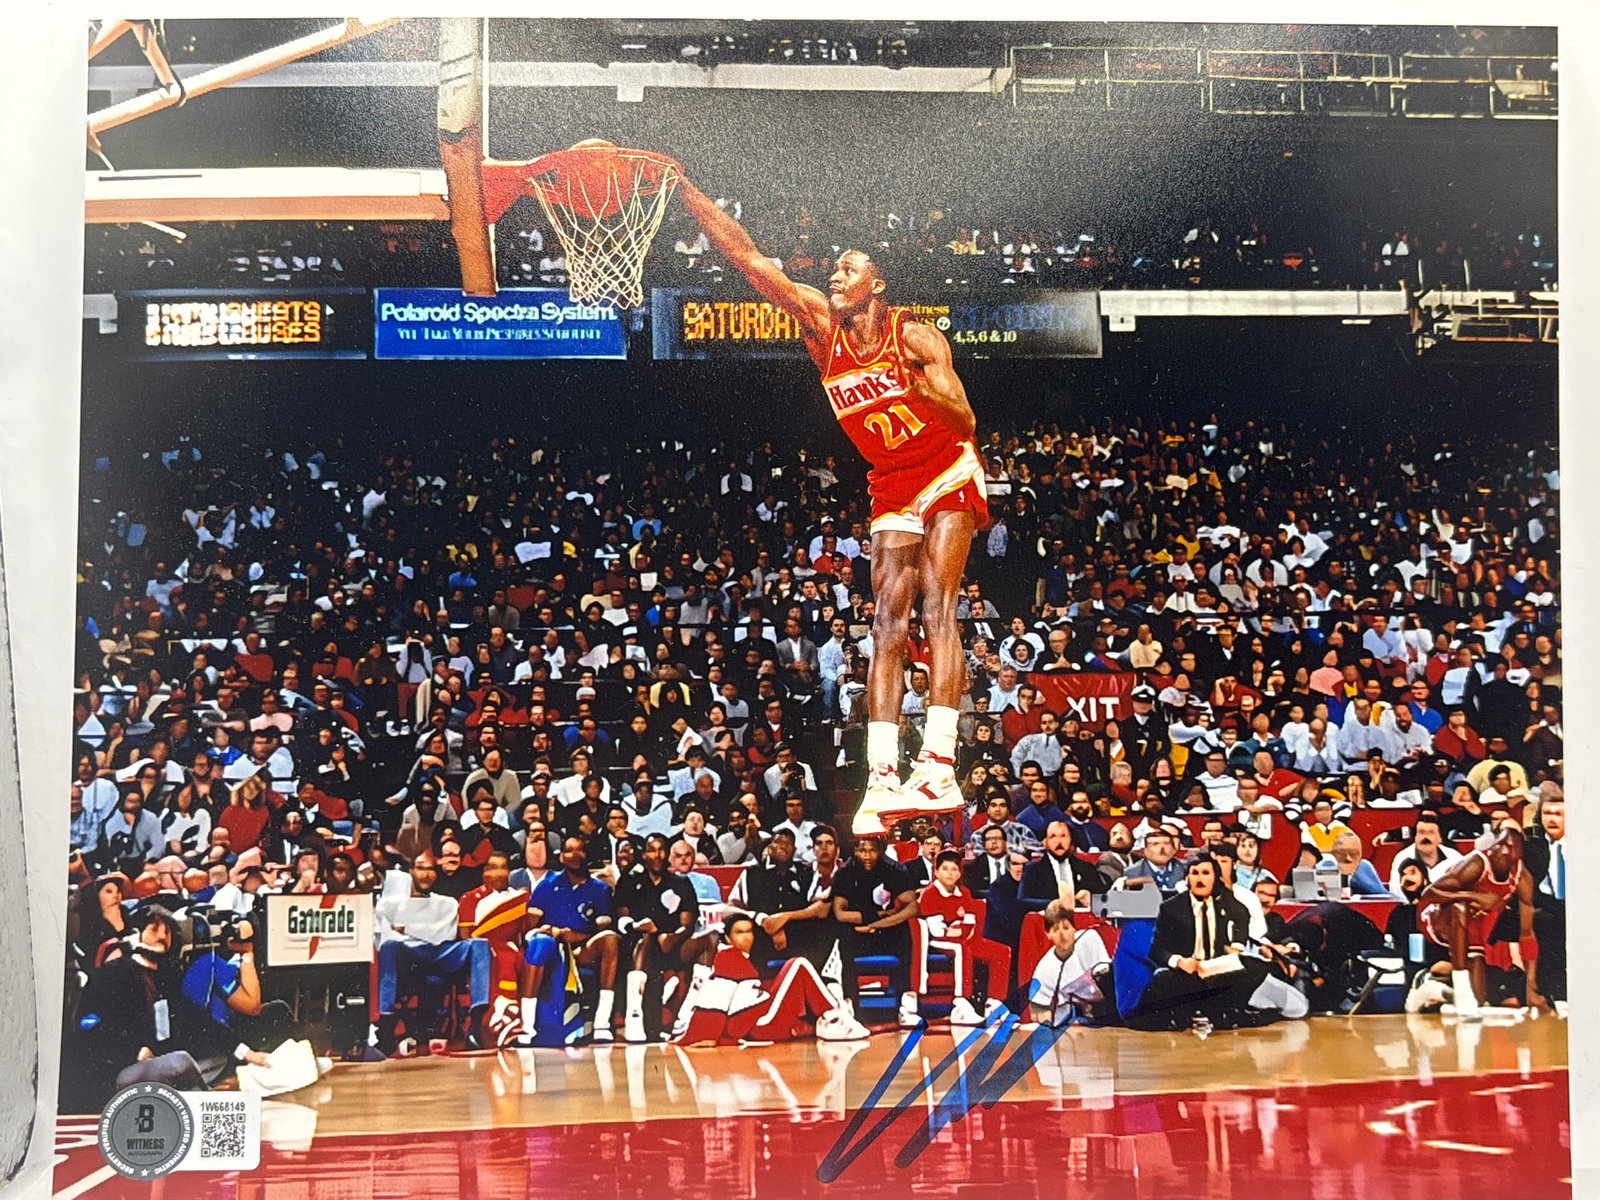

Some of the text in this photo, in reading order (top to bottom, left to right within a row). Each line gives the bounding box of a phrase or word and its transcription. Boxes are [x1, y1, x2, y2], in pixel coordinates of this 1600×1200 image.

[381, 302, 460, 321] Polaroid
[463, 302, 538, 324] Spectra
[953, 331, 1017, 344] 4,5,6 & 10
[828, 369, 901, 411] Hawks
[864, 403, 927, 450] 21
[1064, 696, 1120, 722] XIT
[288, 904, 355, 934] Gatorade
[201, 1101, 246, 1113] 1W668149
[126, 1137, 165, 1150] WITNESS
